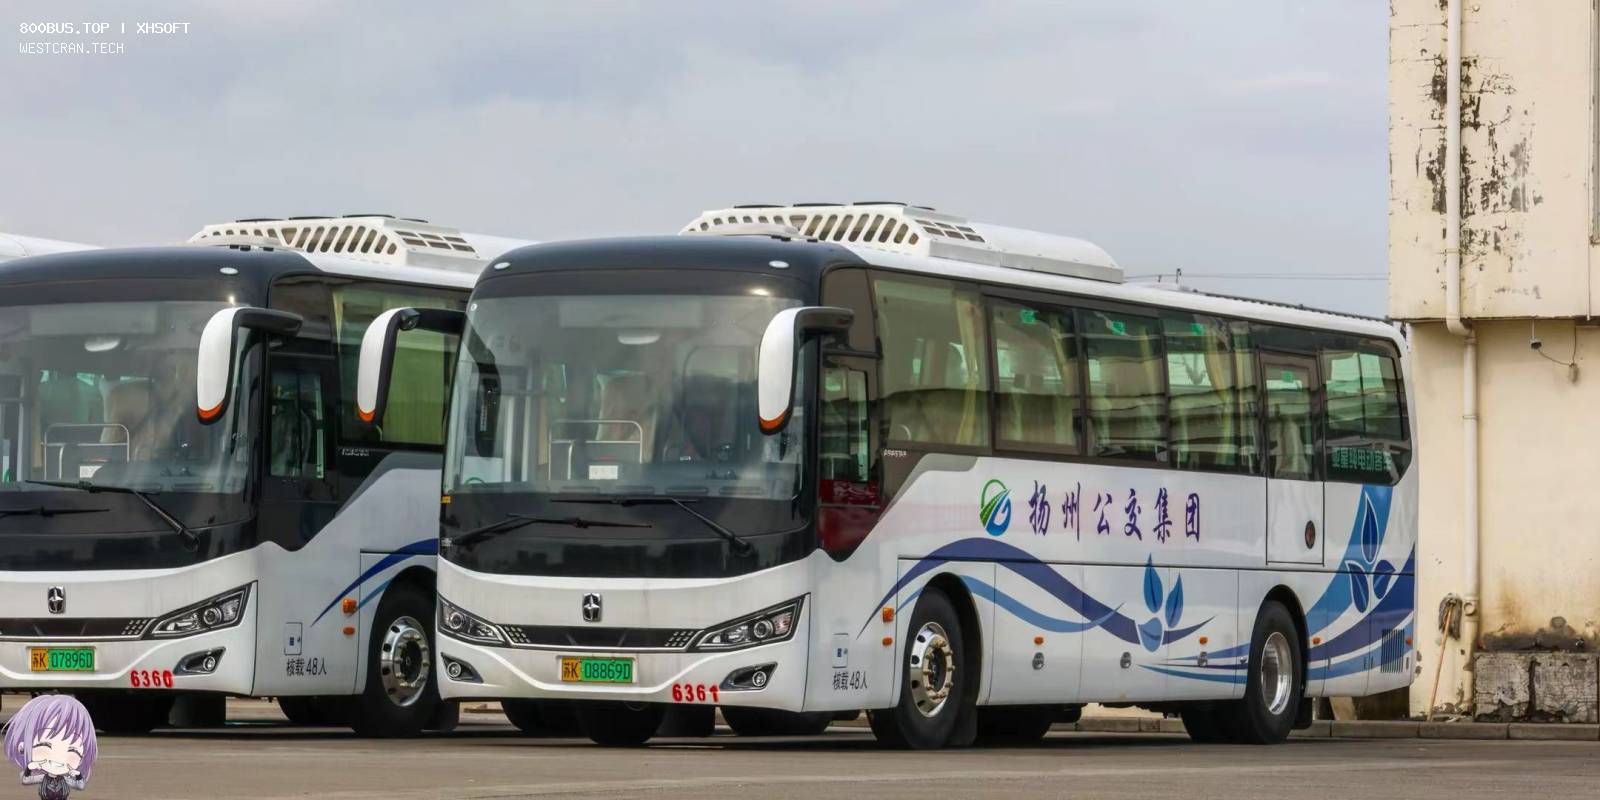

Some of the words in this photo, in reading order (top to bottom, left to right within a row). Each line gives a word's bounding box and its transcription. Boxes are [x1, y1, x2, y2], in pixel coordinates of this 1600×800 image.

[1028, 479, 1200, 544] 扬州公交集团
[51, 652, 94, 669] 07896D
[130, 669, 175, 688] 6360
[563, 661, 579, 679] 苏K
[584, 661, 632, 680] 08869D
[672, 683, 720, 703] 6361
